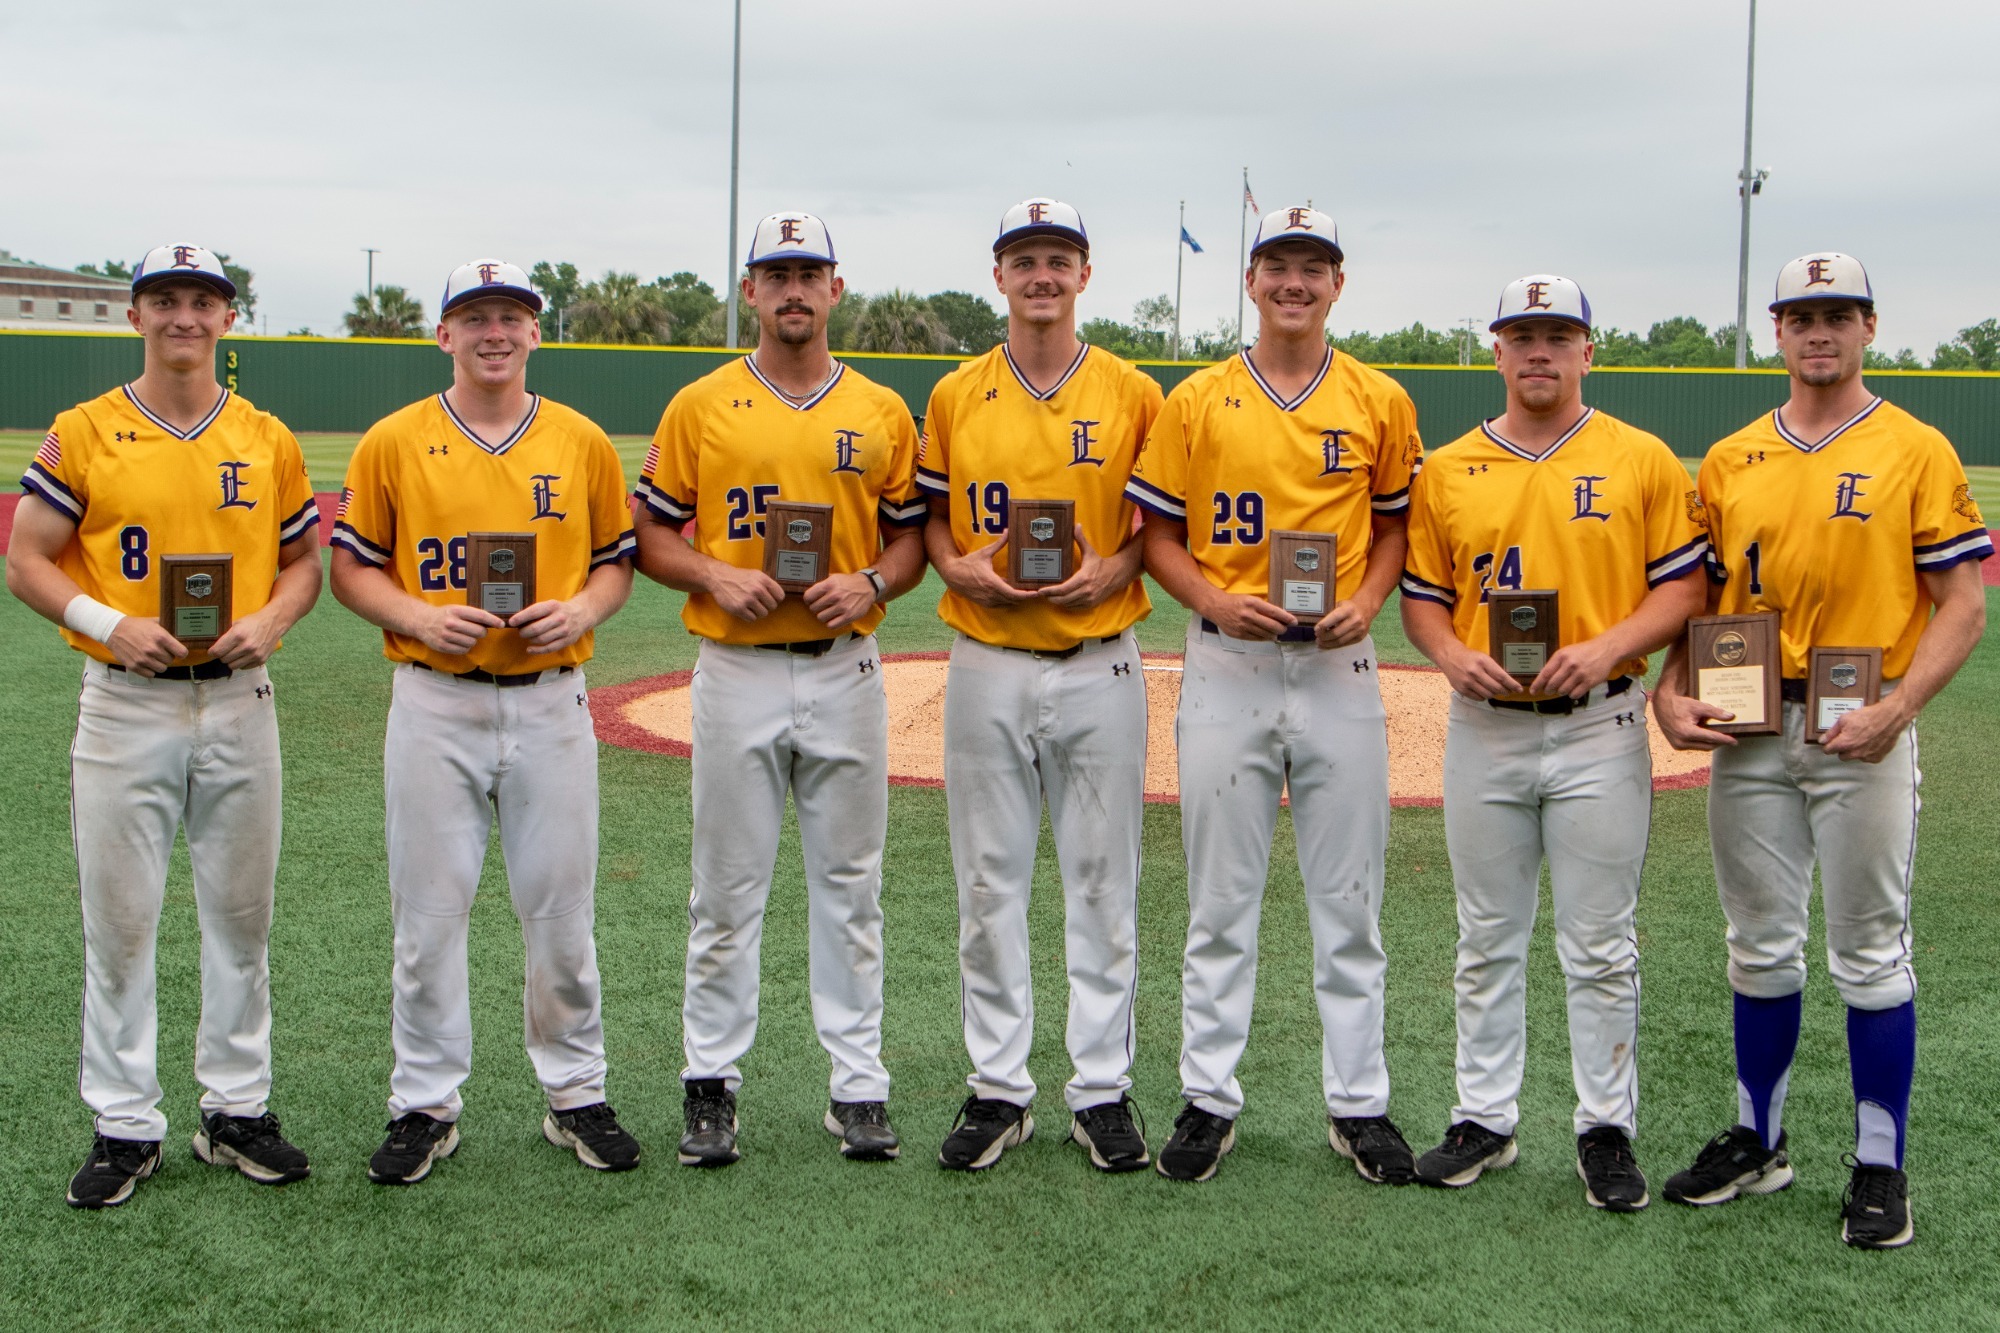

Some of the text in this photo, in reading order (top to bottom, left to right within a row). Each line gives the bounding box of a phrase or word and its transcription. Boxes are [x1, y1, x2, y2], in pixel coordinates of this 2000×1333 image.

[725, 484, 780, 541] 25
[966, 481, 1009, 537] 19
[1212, 491, 1264, 546] 29
[119, 525, 150, 582] 8
[416, 536, 467, 592] 28
[1471, 546, 1523, 606] 24
[1744, 541, 1764, 597] 1
